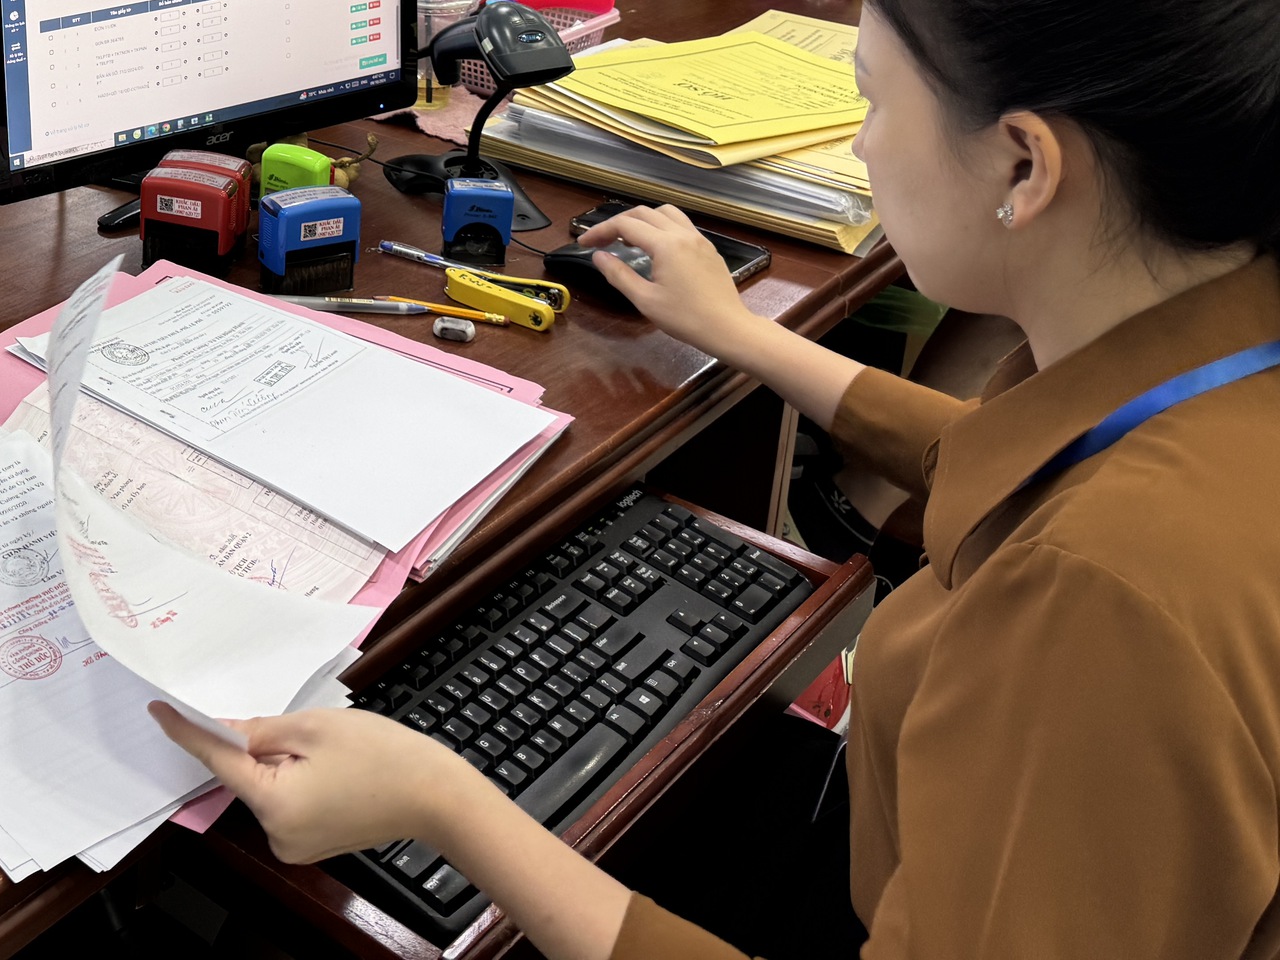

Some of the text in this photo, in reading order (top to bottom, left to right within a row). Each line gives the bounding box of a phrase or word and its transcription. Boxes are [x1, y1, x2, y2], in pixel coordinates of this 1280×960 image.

[206, 131, 234, 145] acer
[617, 490, 643, 508] logitech
[16, 650, 51, 671] THỦ ĐỨC
[396, 854, 410, 868] Shift
[426, 876, 440, 890] Ctrl
